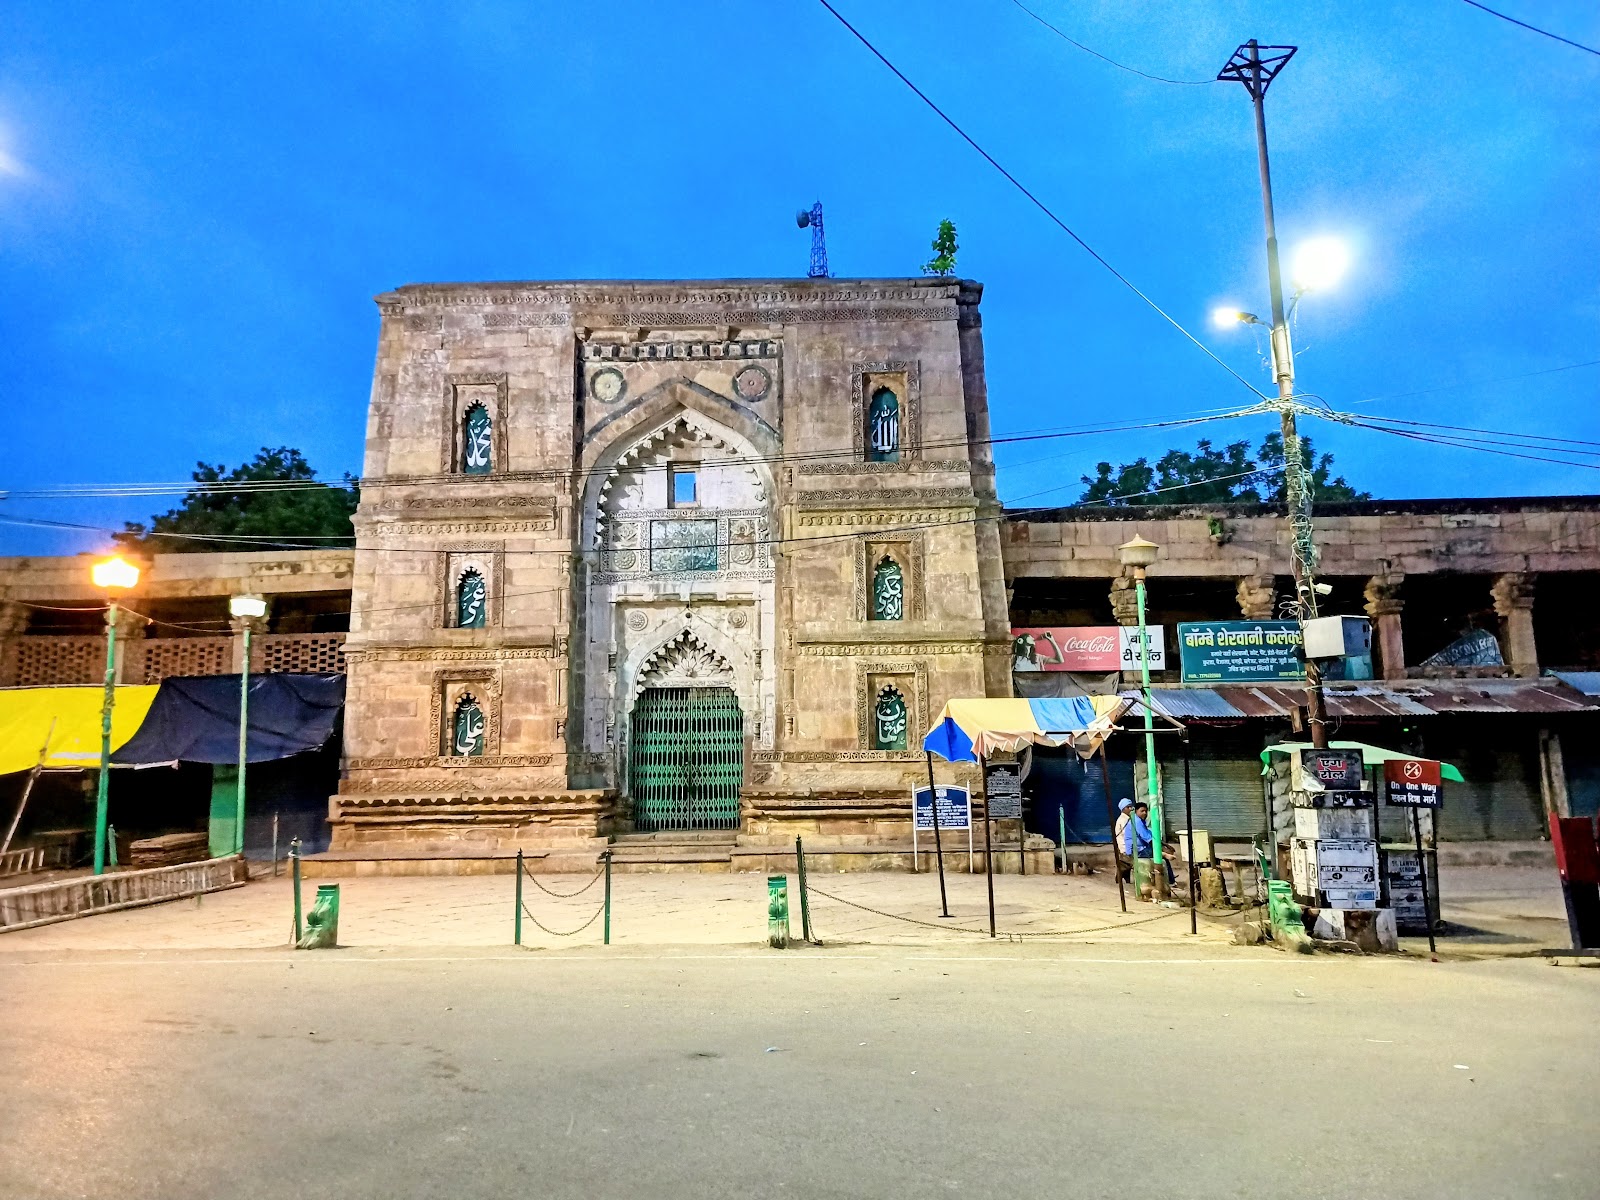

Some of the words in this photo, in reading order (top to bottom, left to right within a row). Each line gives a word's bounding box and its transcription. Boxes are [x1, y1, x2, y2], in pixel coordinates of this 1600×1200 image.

[872, 405, 898, 452] الله
[1184, 627, 1215, 647] बॉम्बे
[1217, 626, 1264, 647] शेरवानी
[1122, 648, 1133, 661] टी
[1320, 758, 1343, 768] एग
[1406, 782, 1419, 791] One
[1421, 783, 1437, 793] Way
[1407, 792, 1421, 803] दिशा
[1422, 793, 1437, 804] मार्ग
